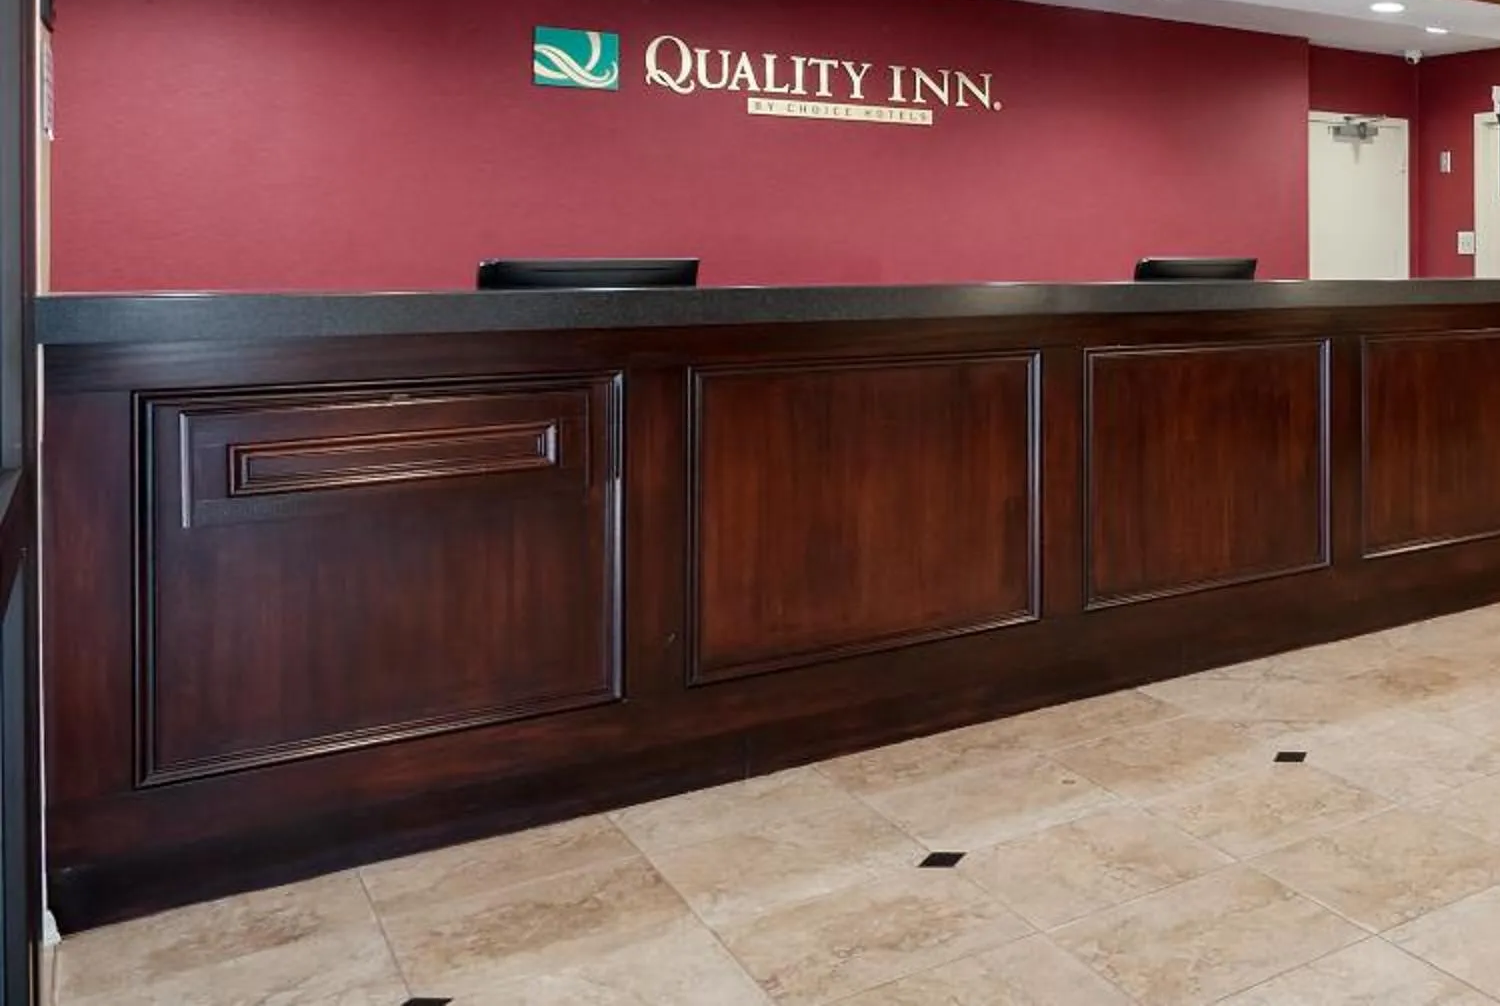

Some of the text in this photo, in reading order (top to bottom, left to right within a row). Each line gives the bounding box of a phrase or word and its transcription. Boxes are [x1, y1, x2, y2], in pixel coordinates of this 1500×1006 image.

[644, 35, 872, 100] QUALITY
[754, 101, 928, 121] BY CHOICE HOTELS
